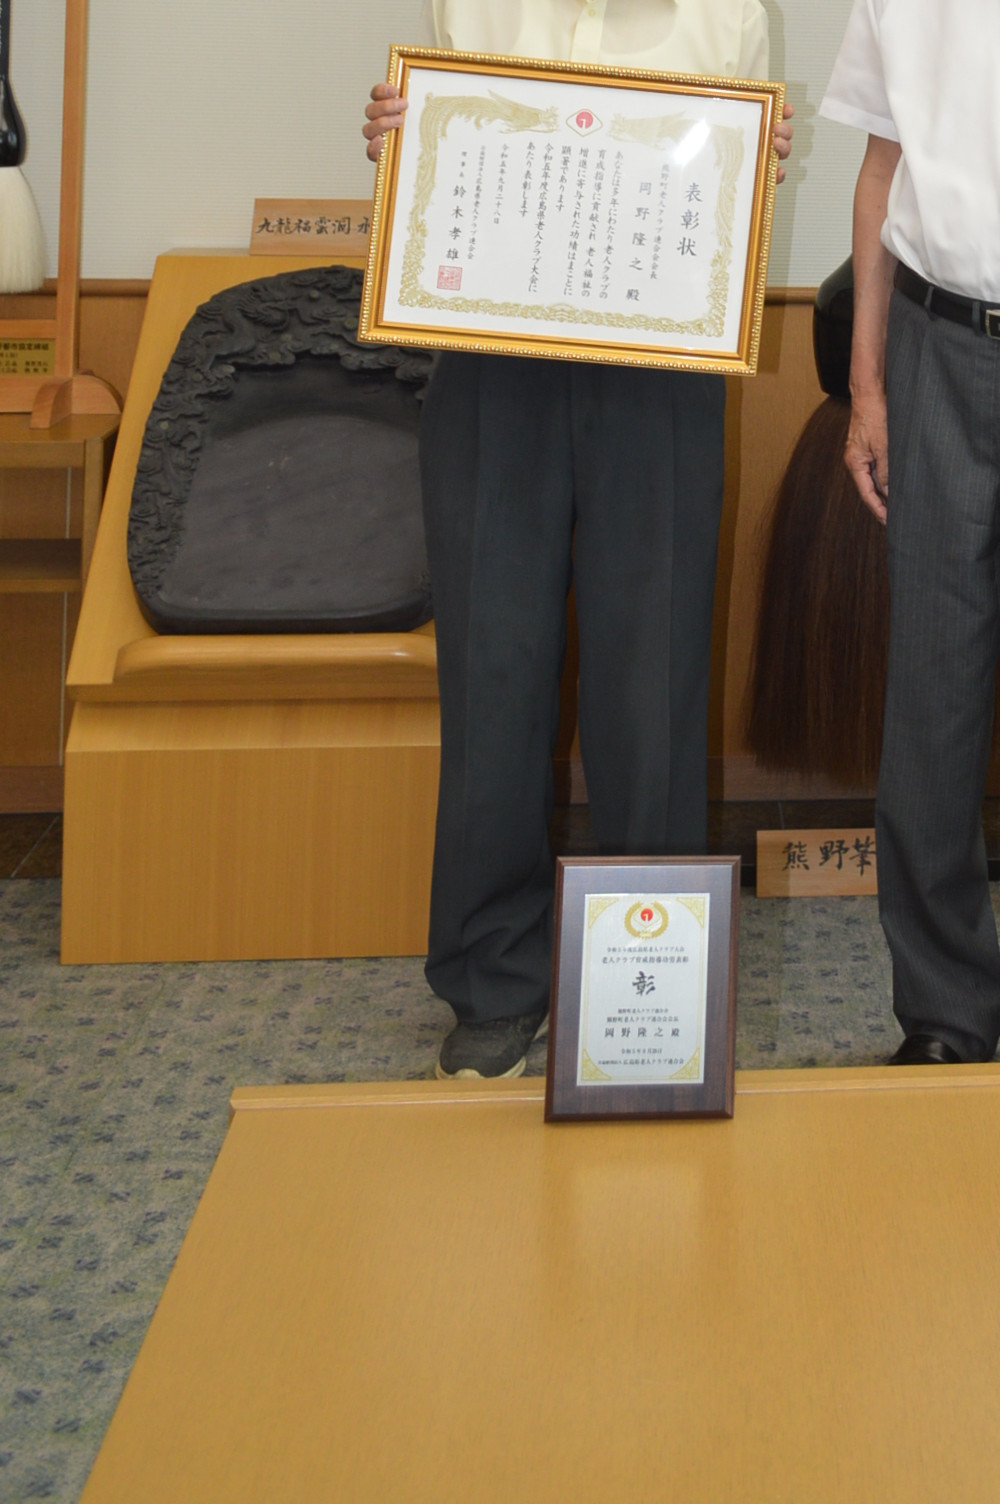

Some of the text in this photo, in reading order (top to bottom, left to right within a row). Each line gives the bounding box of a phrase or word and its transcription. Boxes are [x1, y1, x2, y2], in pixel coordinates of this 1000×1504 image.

[493, 143, 510, 225] 令和五年九月二十八日
[518, 141, 536, 218] あたり表彰します
[528, 142, 554, 294] 令和五年度広島県老人クラブ大会に
[555, 145, 573, 212] 顕著であります
[562, 148, 590, 297] 増進に寄与された功績はまことに
[598, 150, 624, 300] あなたは多年にわたり老人クラブの
[677, 181, 704, 257] 表彰状
[632, 970, 656, 996] 彰
